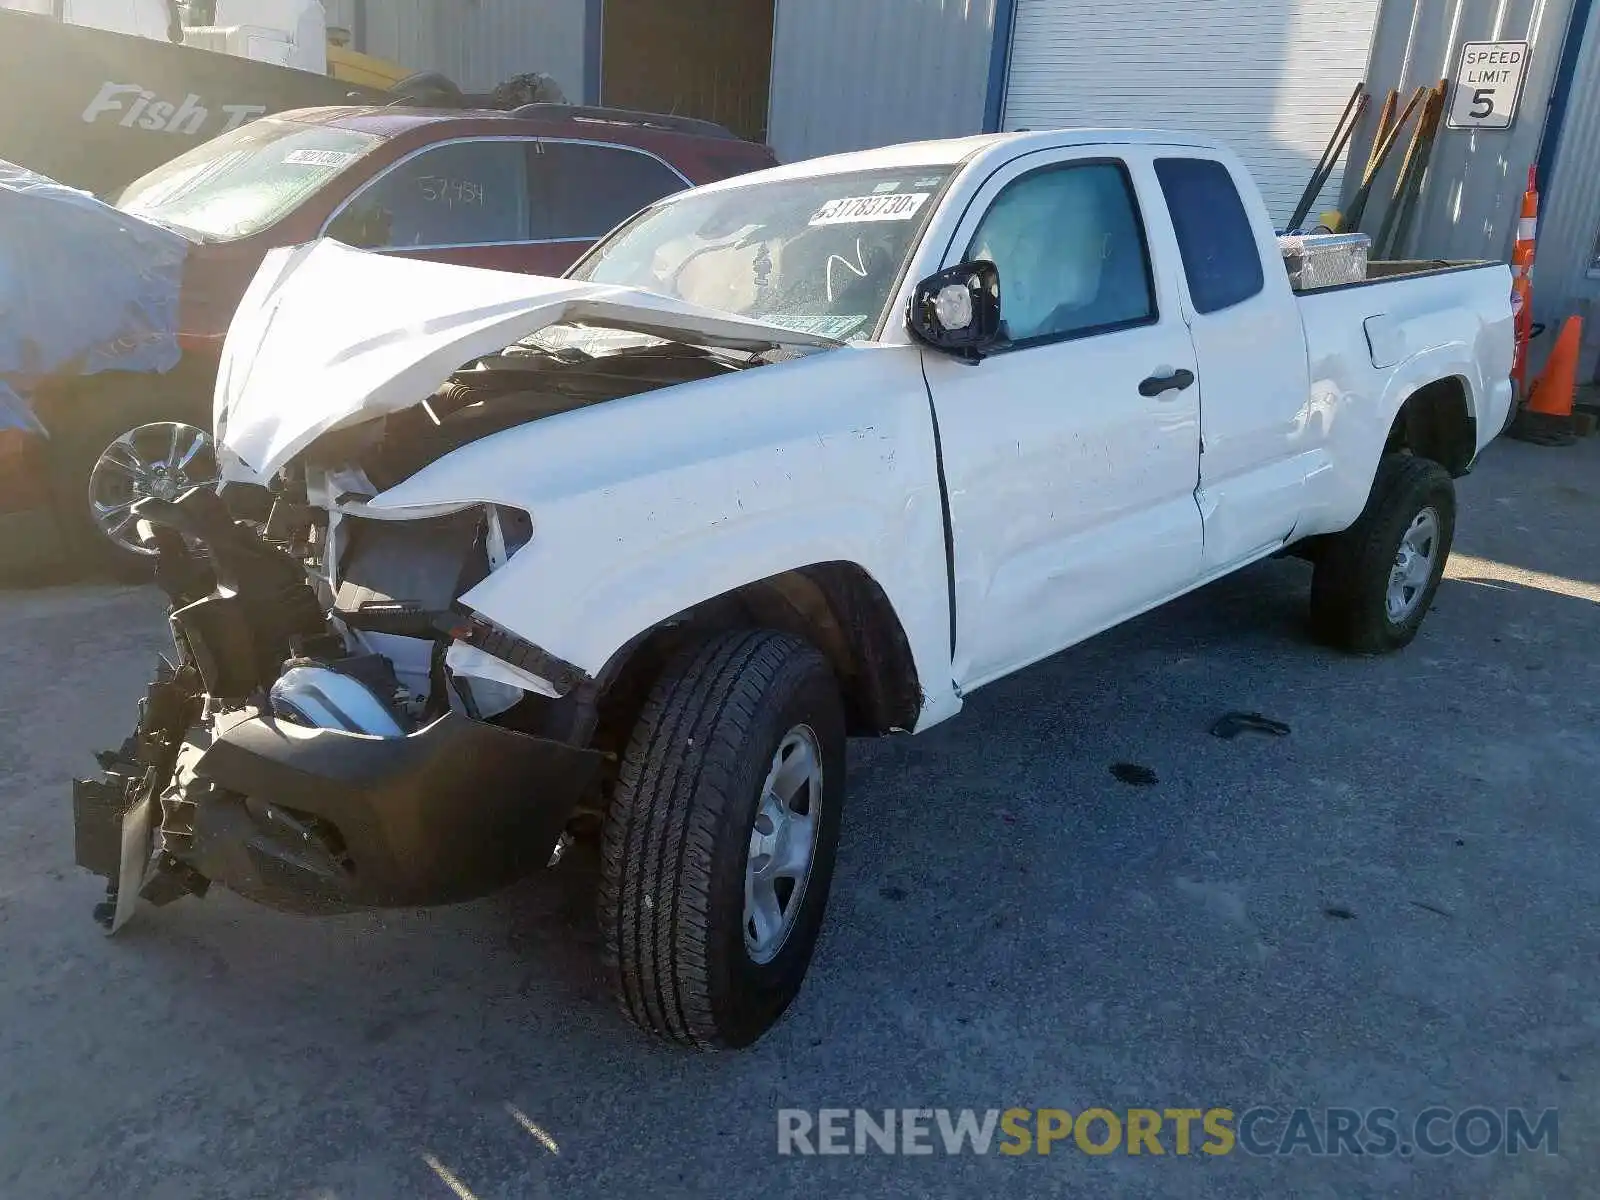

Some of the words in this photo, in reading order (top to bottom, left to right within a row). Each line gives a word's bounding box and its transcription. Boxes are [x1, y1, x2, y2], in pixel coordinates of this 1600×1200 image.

[1466, 51, 1521, 64] SPEED
[1467, 70, 1511, 83] LIMIT
[82, 81, 208, 135] Fish
[1468, 88, 1496, 119] 5
